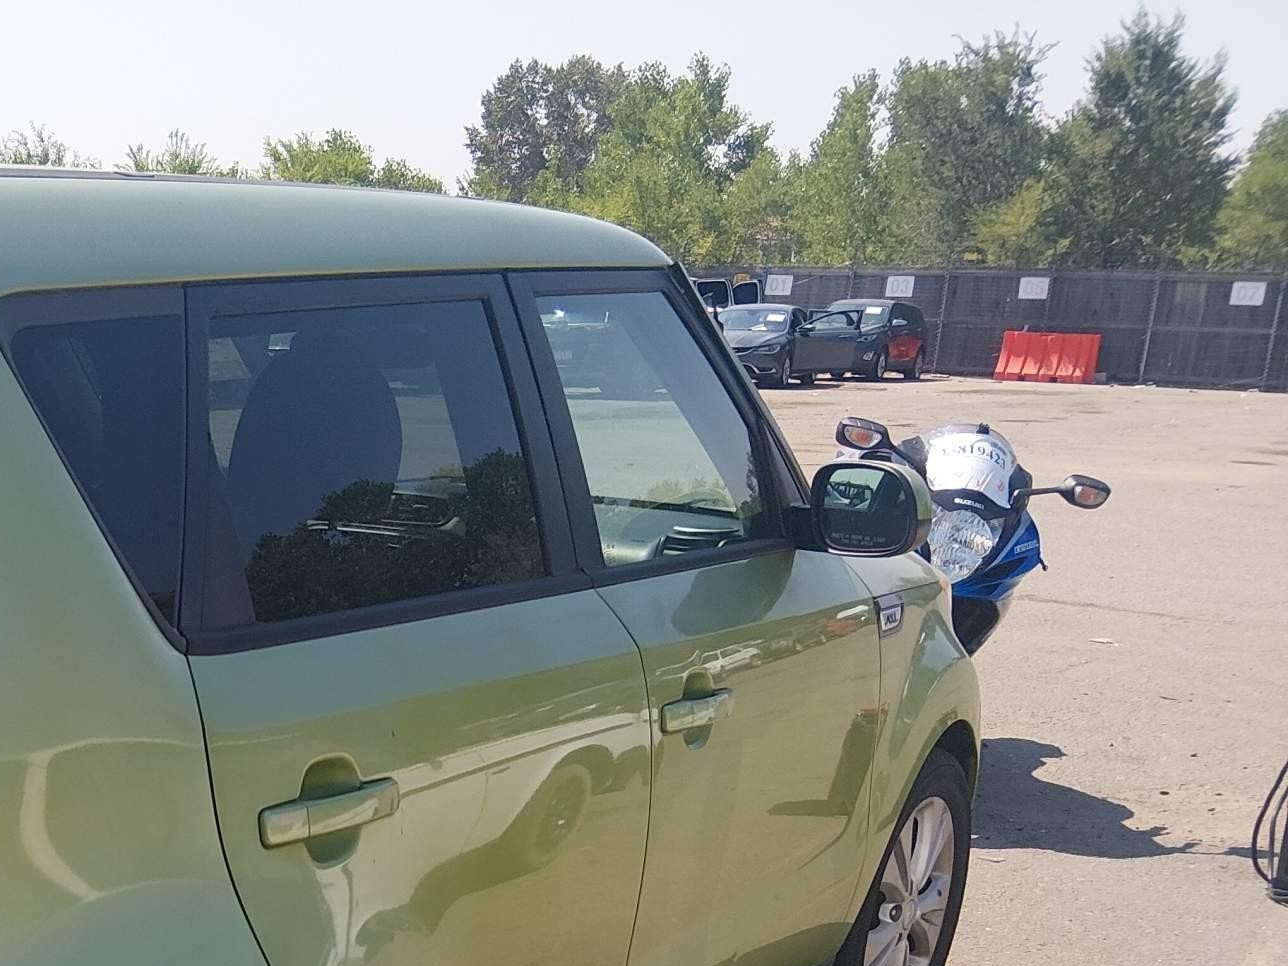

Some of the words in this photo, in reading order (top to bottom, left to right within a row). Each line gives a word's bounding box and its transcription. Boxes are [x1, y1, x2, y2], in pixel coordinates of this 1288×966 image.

[769, 277, 788, 292] 01
[891, 279, 909, 293] 03
[1236, 286, 1259, 302] 07
